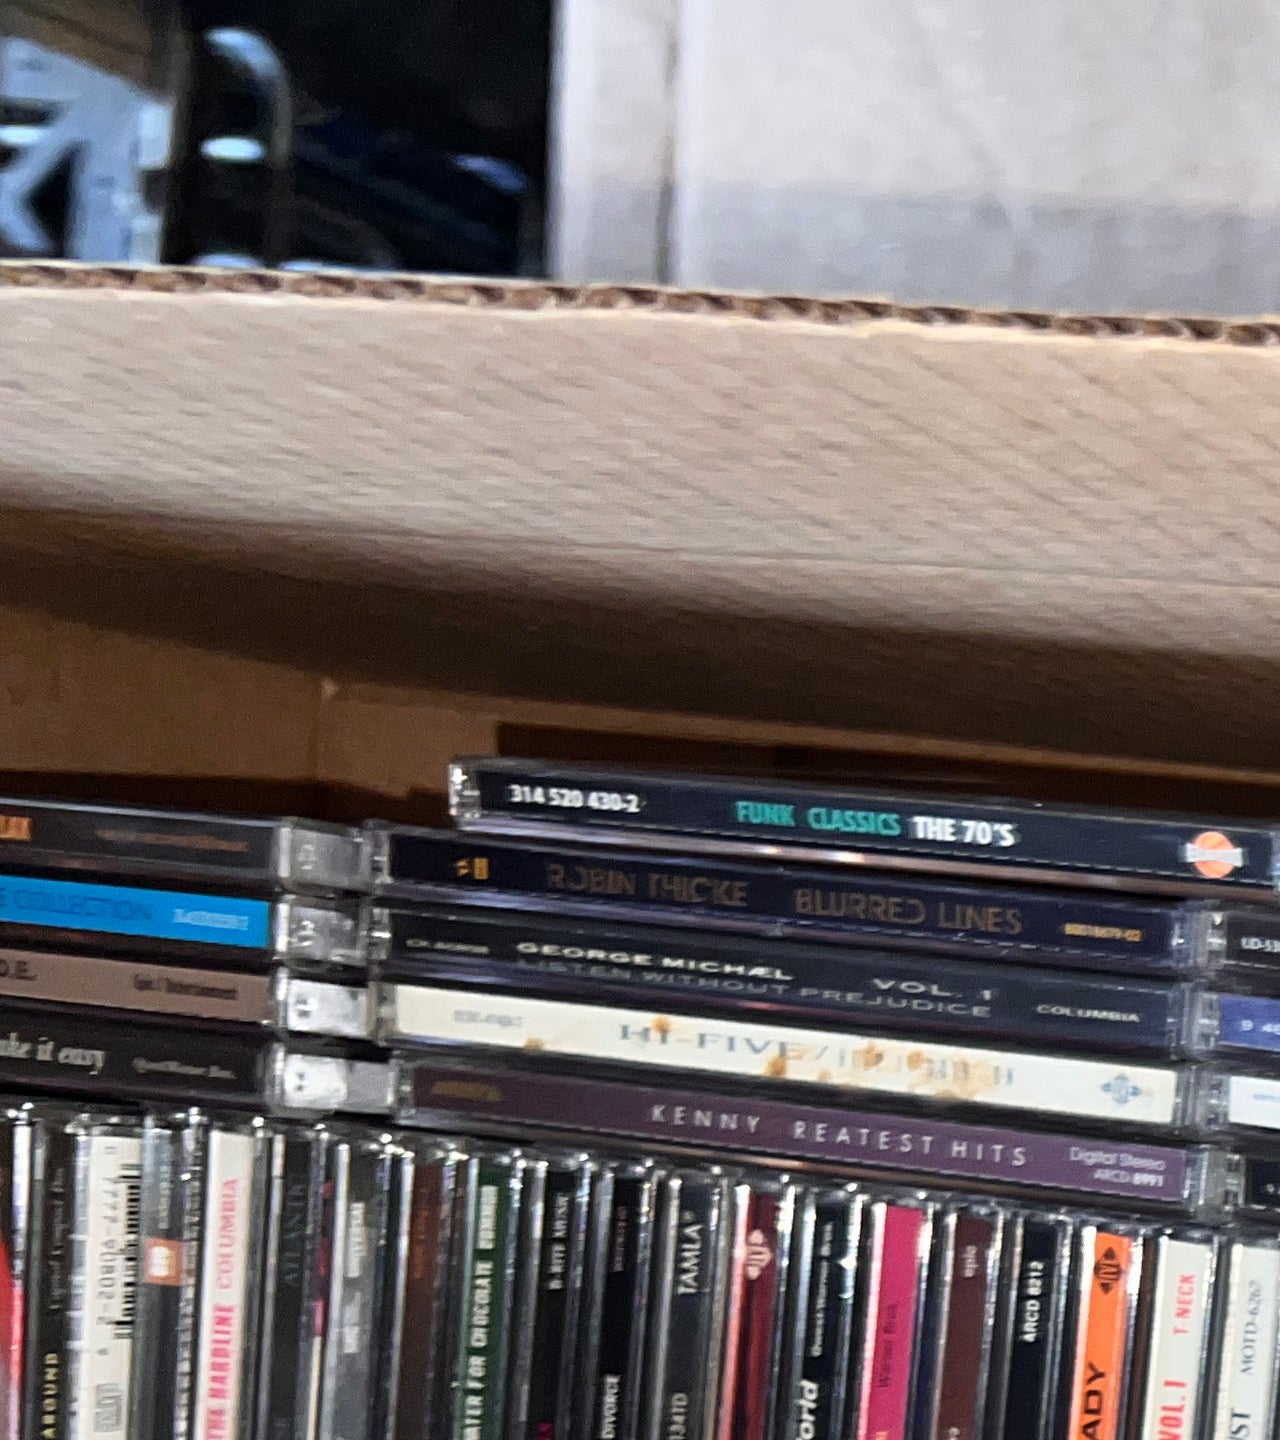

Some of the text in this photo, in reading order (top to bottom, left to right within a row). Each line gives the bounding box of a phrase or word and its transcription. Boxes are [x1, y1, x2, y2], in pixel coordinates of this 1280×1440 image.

[734, 801, 957, 841] FUNK CLASSICS THE
[937, 902, 1023, 935] LINES
[516, 942, 652, 965] GEORGE
[1036, 1004, 1139, 1022] COLUMBIA
[951, 1140, 1027, 1166] HITS
[216, 1178, 239, 1289] COLUMBIA
[962, 1245, 979, 1277] epic
[469, 1260, 493, 1348] CHOCOLATE
[1172, 1273, 1195, 1335] T-NECK
[465, 1355, 486, 1389] FOR
[600, 1374, 619, 1439] DIVORCE
